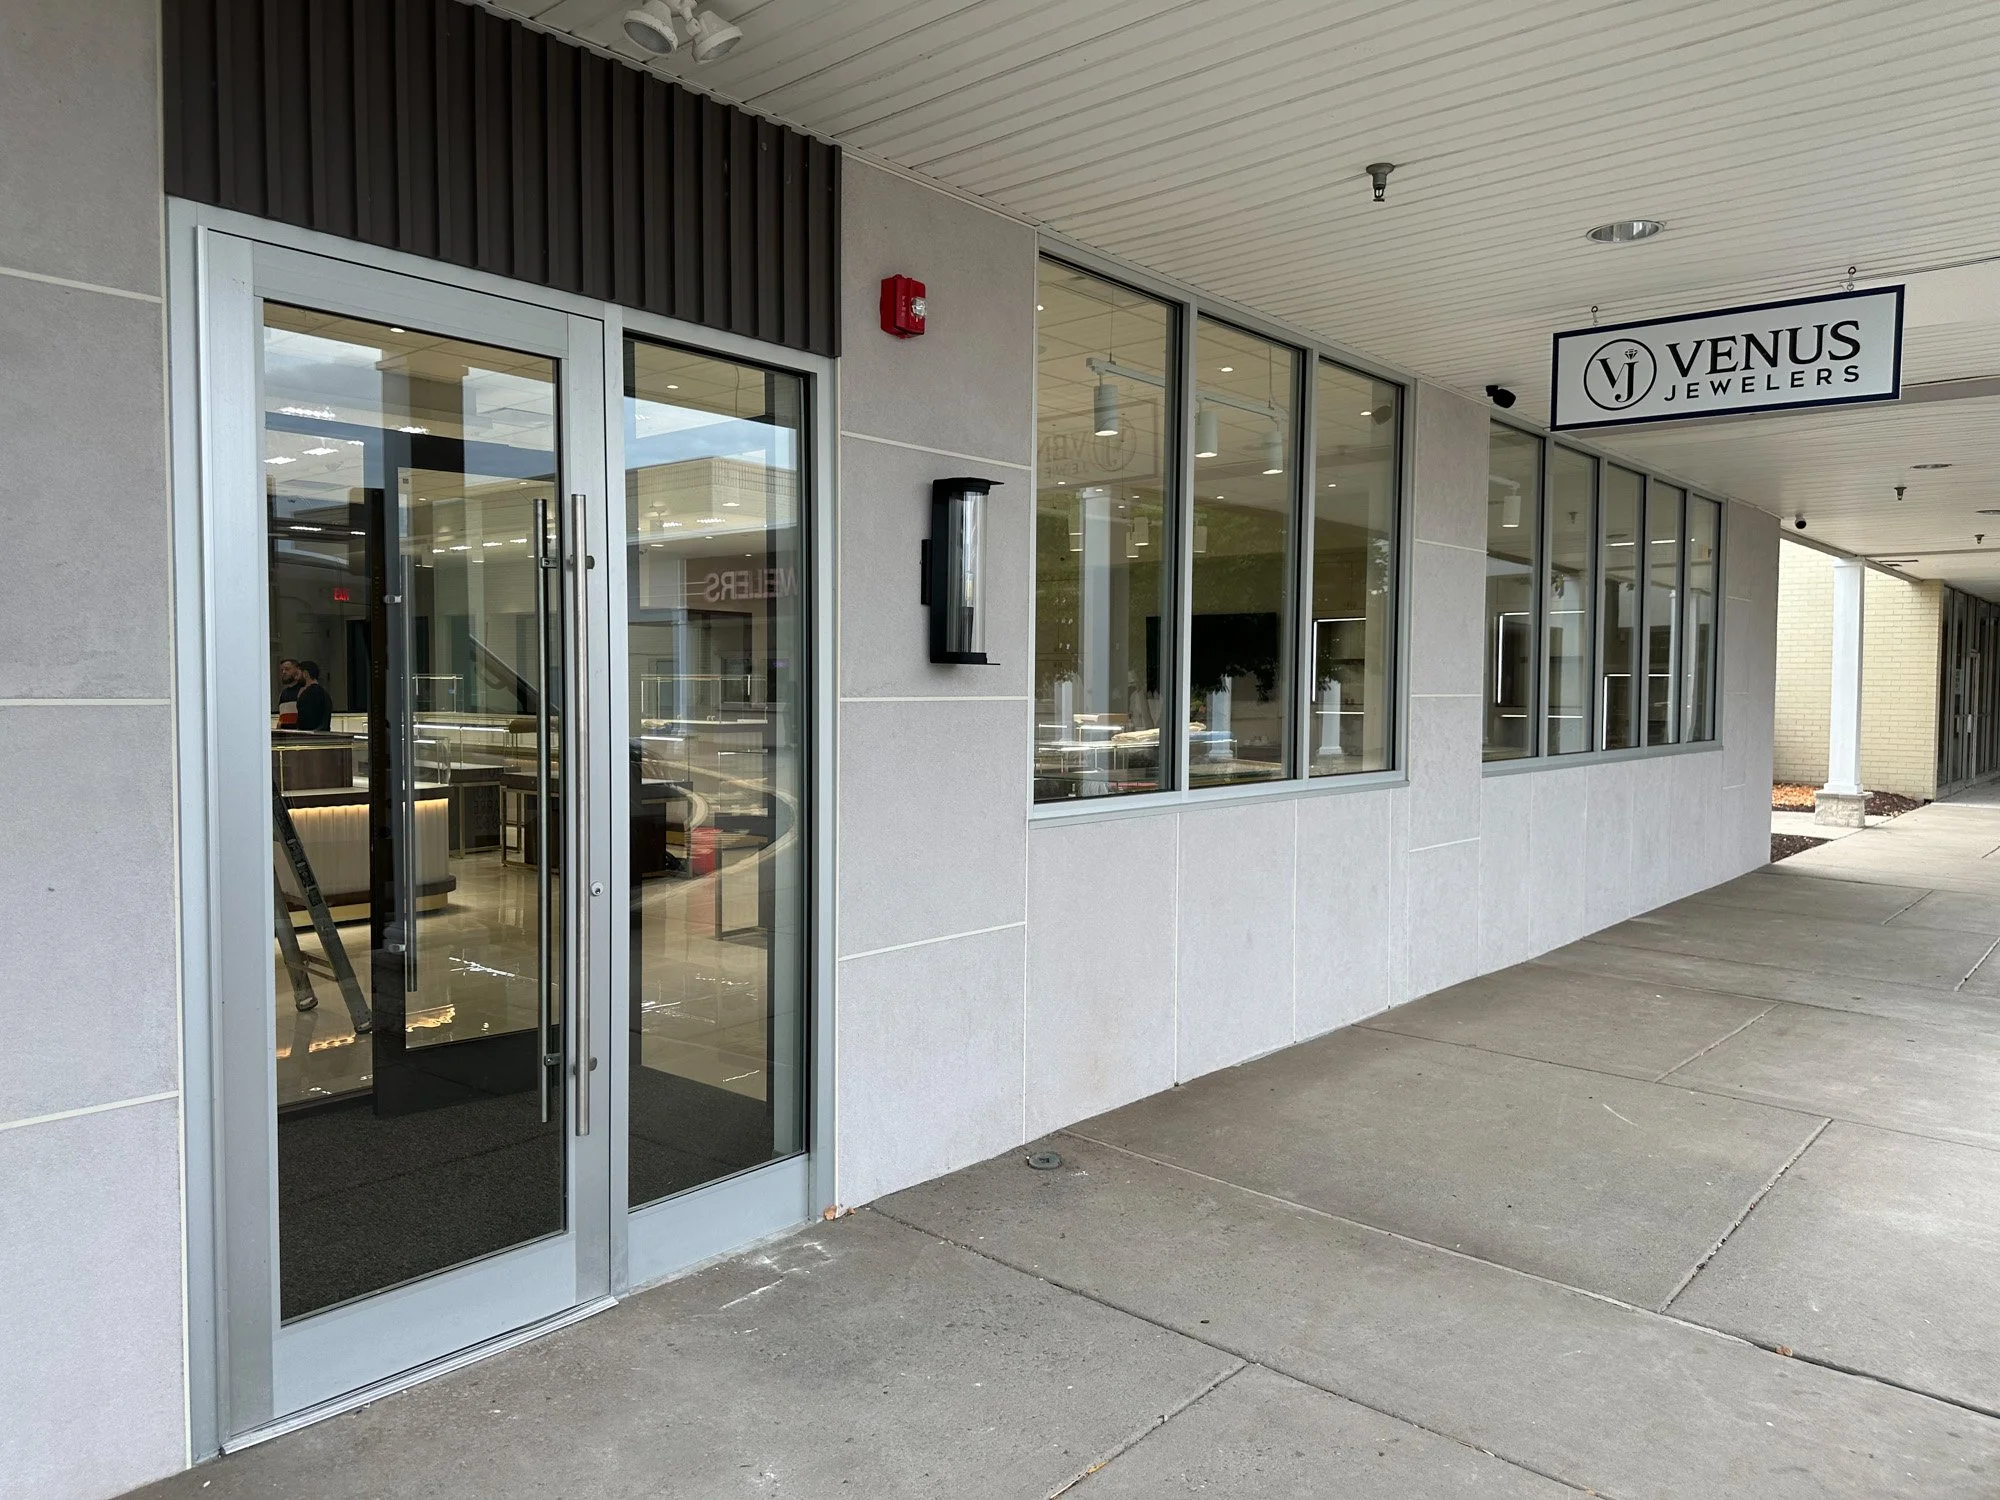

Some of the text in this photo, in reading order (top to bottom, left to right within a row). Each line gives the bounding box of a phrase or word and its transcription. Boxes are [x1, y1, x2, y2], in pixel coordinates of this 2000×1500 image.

[1665, 320, 1861, 378] VENUS
[1596, 357, 1639, 403] VJ
[1664, 364, 1860, 402] JEWELERS
